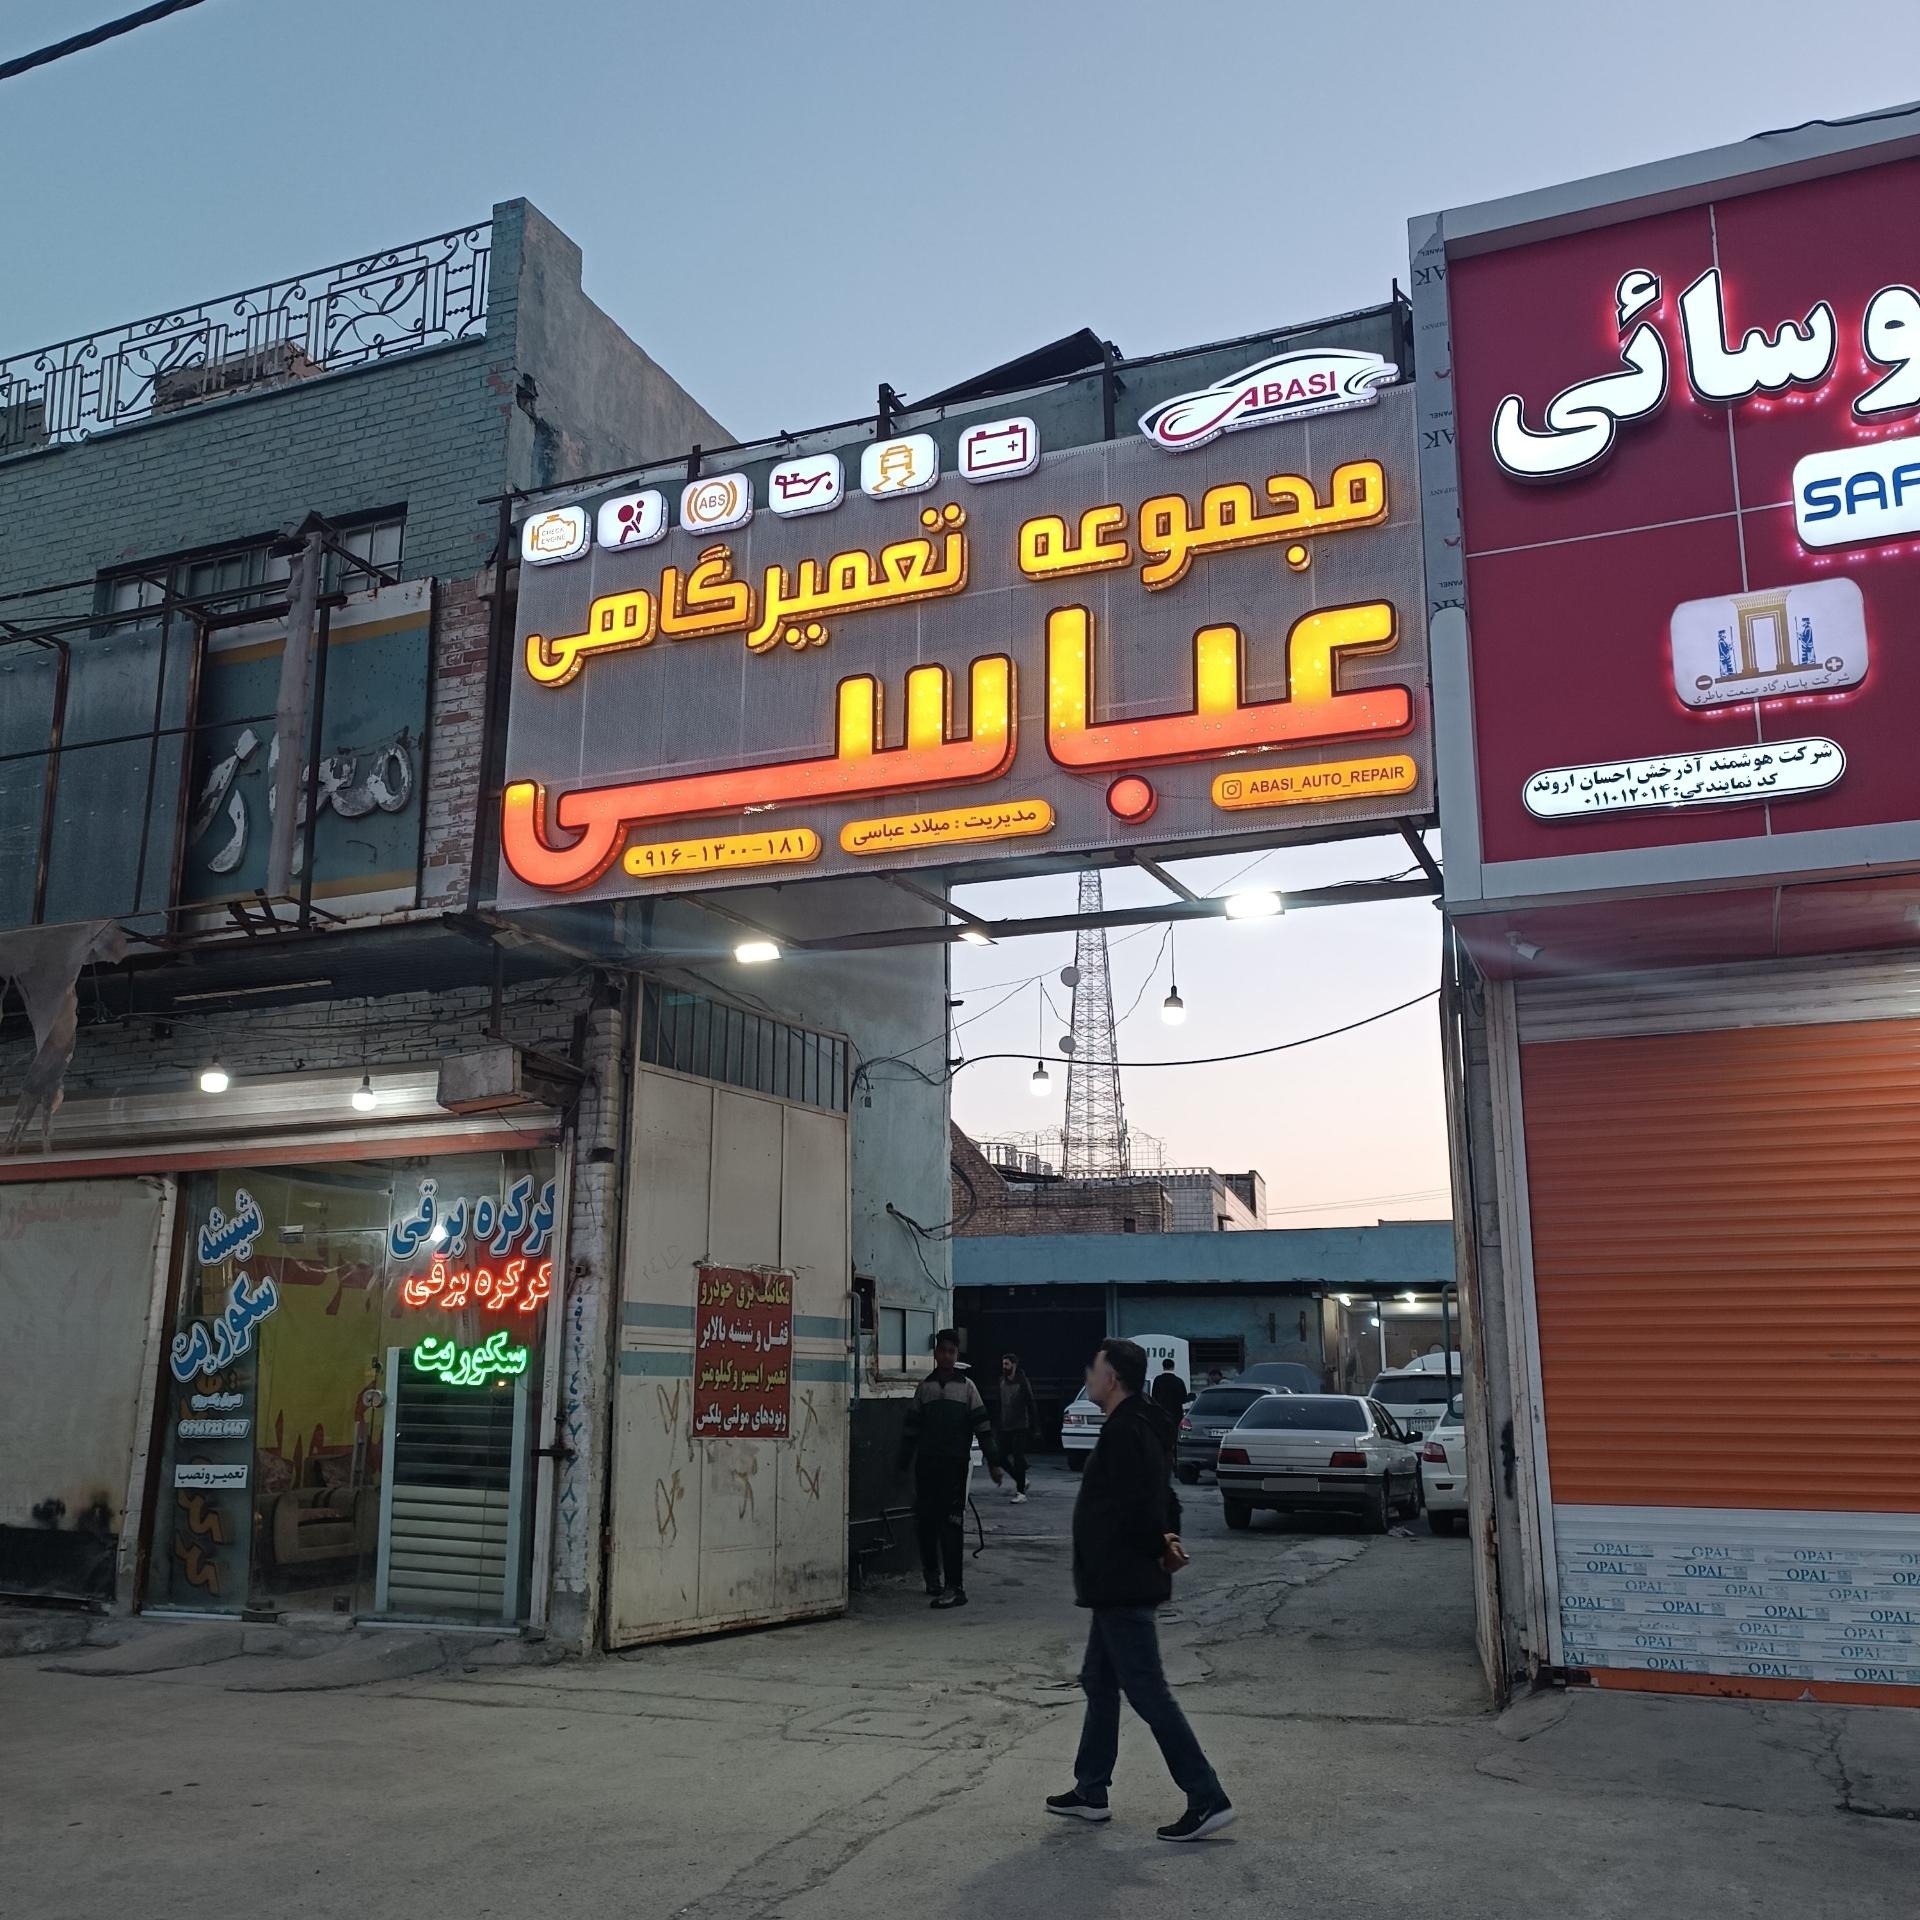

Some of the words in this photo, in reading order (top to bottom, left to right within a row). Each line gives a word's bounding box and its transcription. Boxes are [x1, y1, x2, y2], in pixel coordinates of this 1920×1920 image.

[1230, 370, 1337, 408] ABASI
[699, 494, 726, 510] ABS
[541, 527, 565, 537] CHECK
[1018, 459, 1388, 590] مجموعه
[541, 534, 567, 545] ENGINE
[525, 502, 969, 688] تعمیرگاهی
[1726, 686, 1760, 698] صنعت
[1811, 672, 1850, 686] شرکت
[1693, 689, 1723, 705] باطری
[502, 598, 1417, 893] عباسی
[1778, 744, 1833, 766] شرکت
[1636, 756, 1702, 785] آذرخش
[1709, 752, 1774, 772] هوشمند
[1249, 766, 1405, 795] ABASI_AUTO_REPAIR
[1533, 774, 1575, 795] اروند
[1579, 767, 1632, 791] احسان
[1757, 773, 1779, 787] کد
[853, 823, 905, 847] عباسی
[910, 818, 950, 836] میلاد
[198, 1188, 265, 1266] شیشه
[388, 1178, 469, 1262] برقی
[700, 1275, 734, 1306] خودرو
[170, 1270, 280, 1383] سکوریت
[700, 1315, 727, 1349] بالابر
[728, 1318, 753, 1349] شیشه
[763, 1320, 789, 1352] قفل
[755, 1331, 761, 1352] و
[413, 1331, 528, 1386] سکوریت
[765, 1364, 787, 1393] تعمیر
[723, 1403, 750, 1431] مولتی
[1587, 1560, 1626, 1573] OPAL
[1684, 1564, 1726, 1577] OPAL
[1787, 1568, 1830, 1581] OPAL
[1565, 1596, 1605, 1609] OPAL
[1663, 1600, 1704, 1613] OPAL
[1765, 1605, 1807, 1619] OPAL
[1870, 1610, 1915, 1624] OPAL
[1647, 1657, 1689, 1671] OPAL
[1748, 1662, 1792, 1676] OPAL
[1854, 1667, 1899, 1681] OPAL
